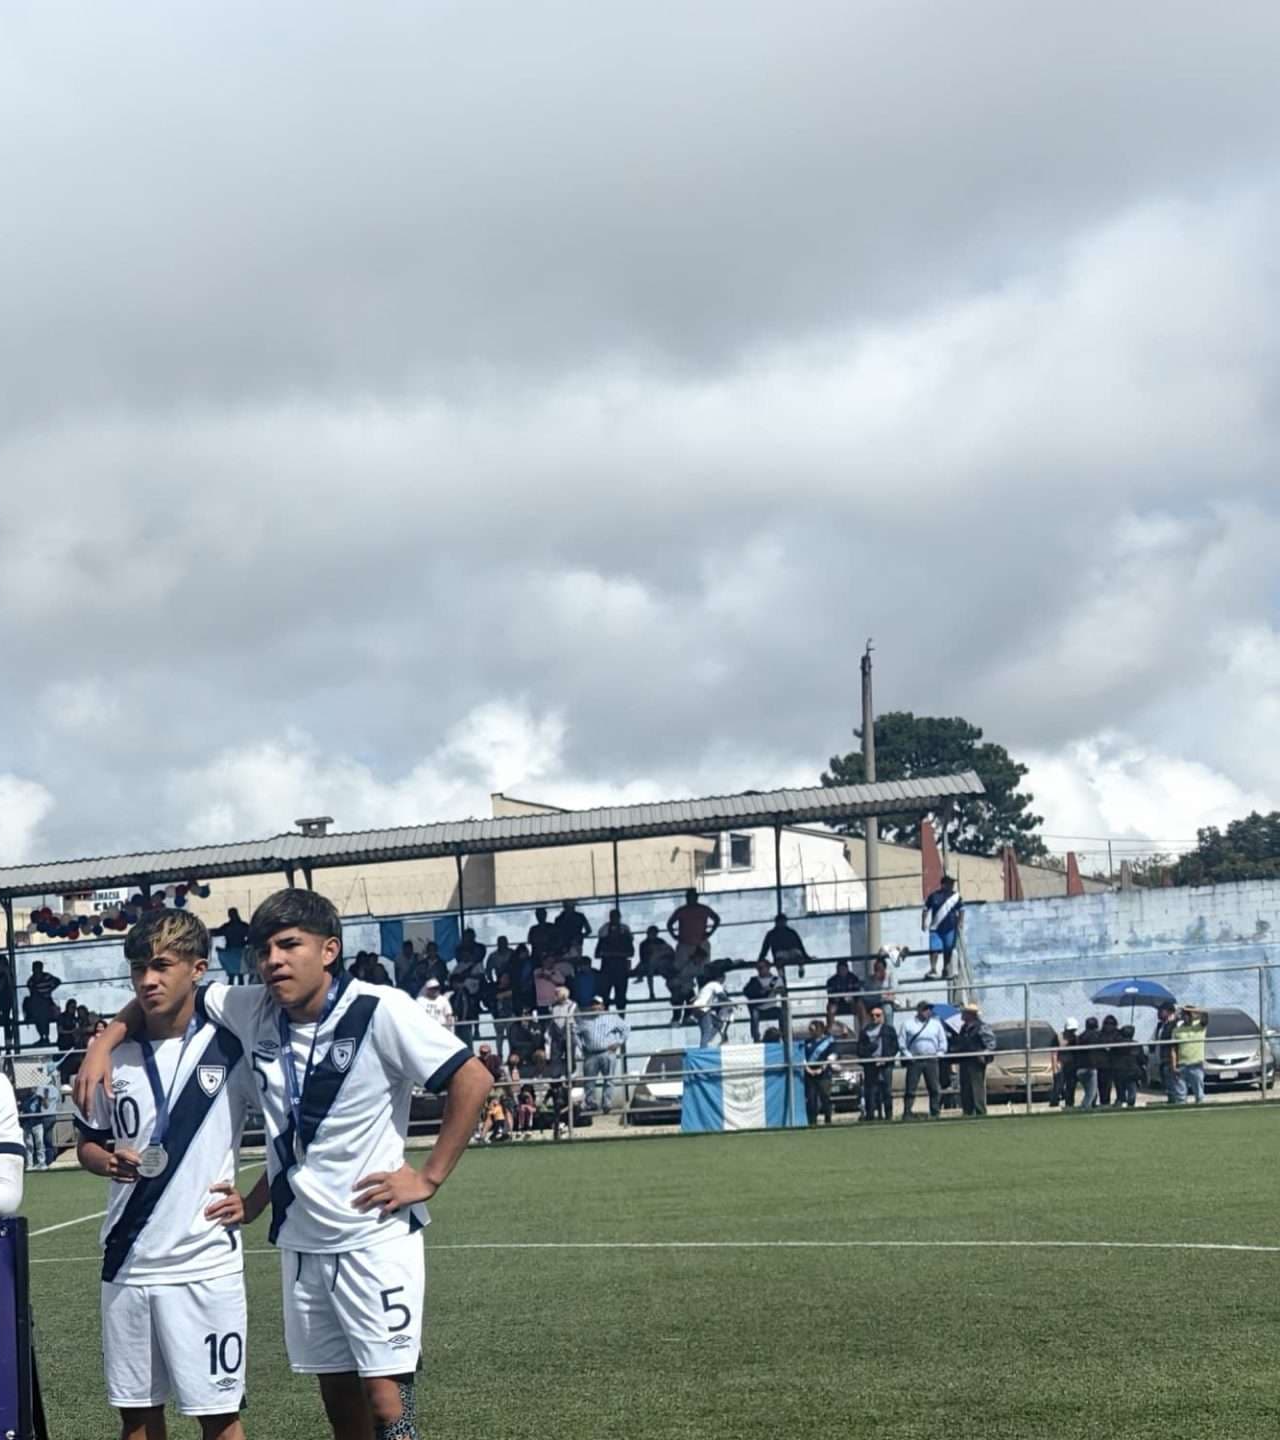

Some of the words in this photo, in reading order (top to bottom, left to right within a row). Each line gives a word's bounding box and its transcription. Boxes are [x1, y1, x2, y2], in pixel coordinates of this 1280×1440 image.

[113, 1095, 140, 1139] 10
[380, 1285, 412, 1332] 5
[203, 1331, 242, 1376] 10
